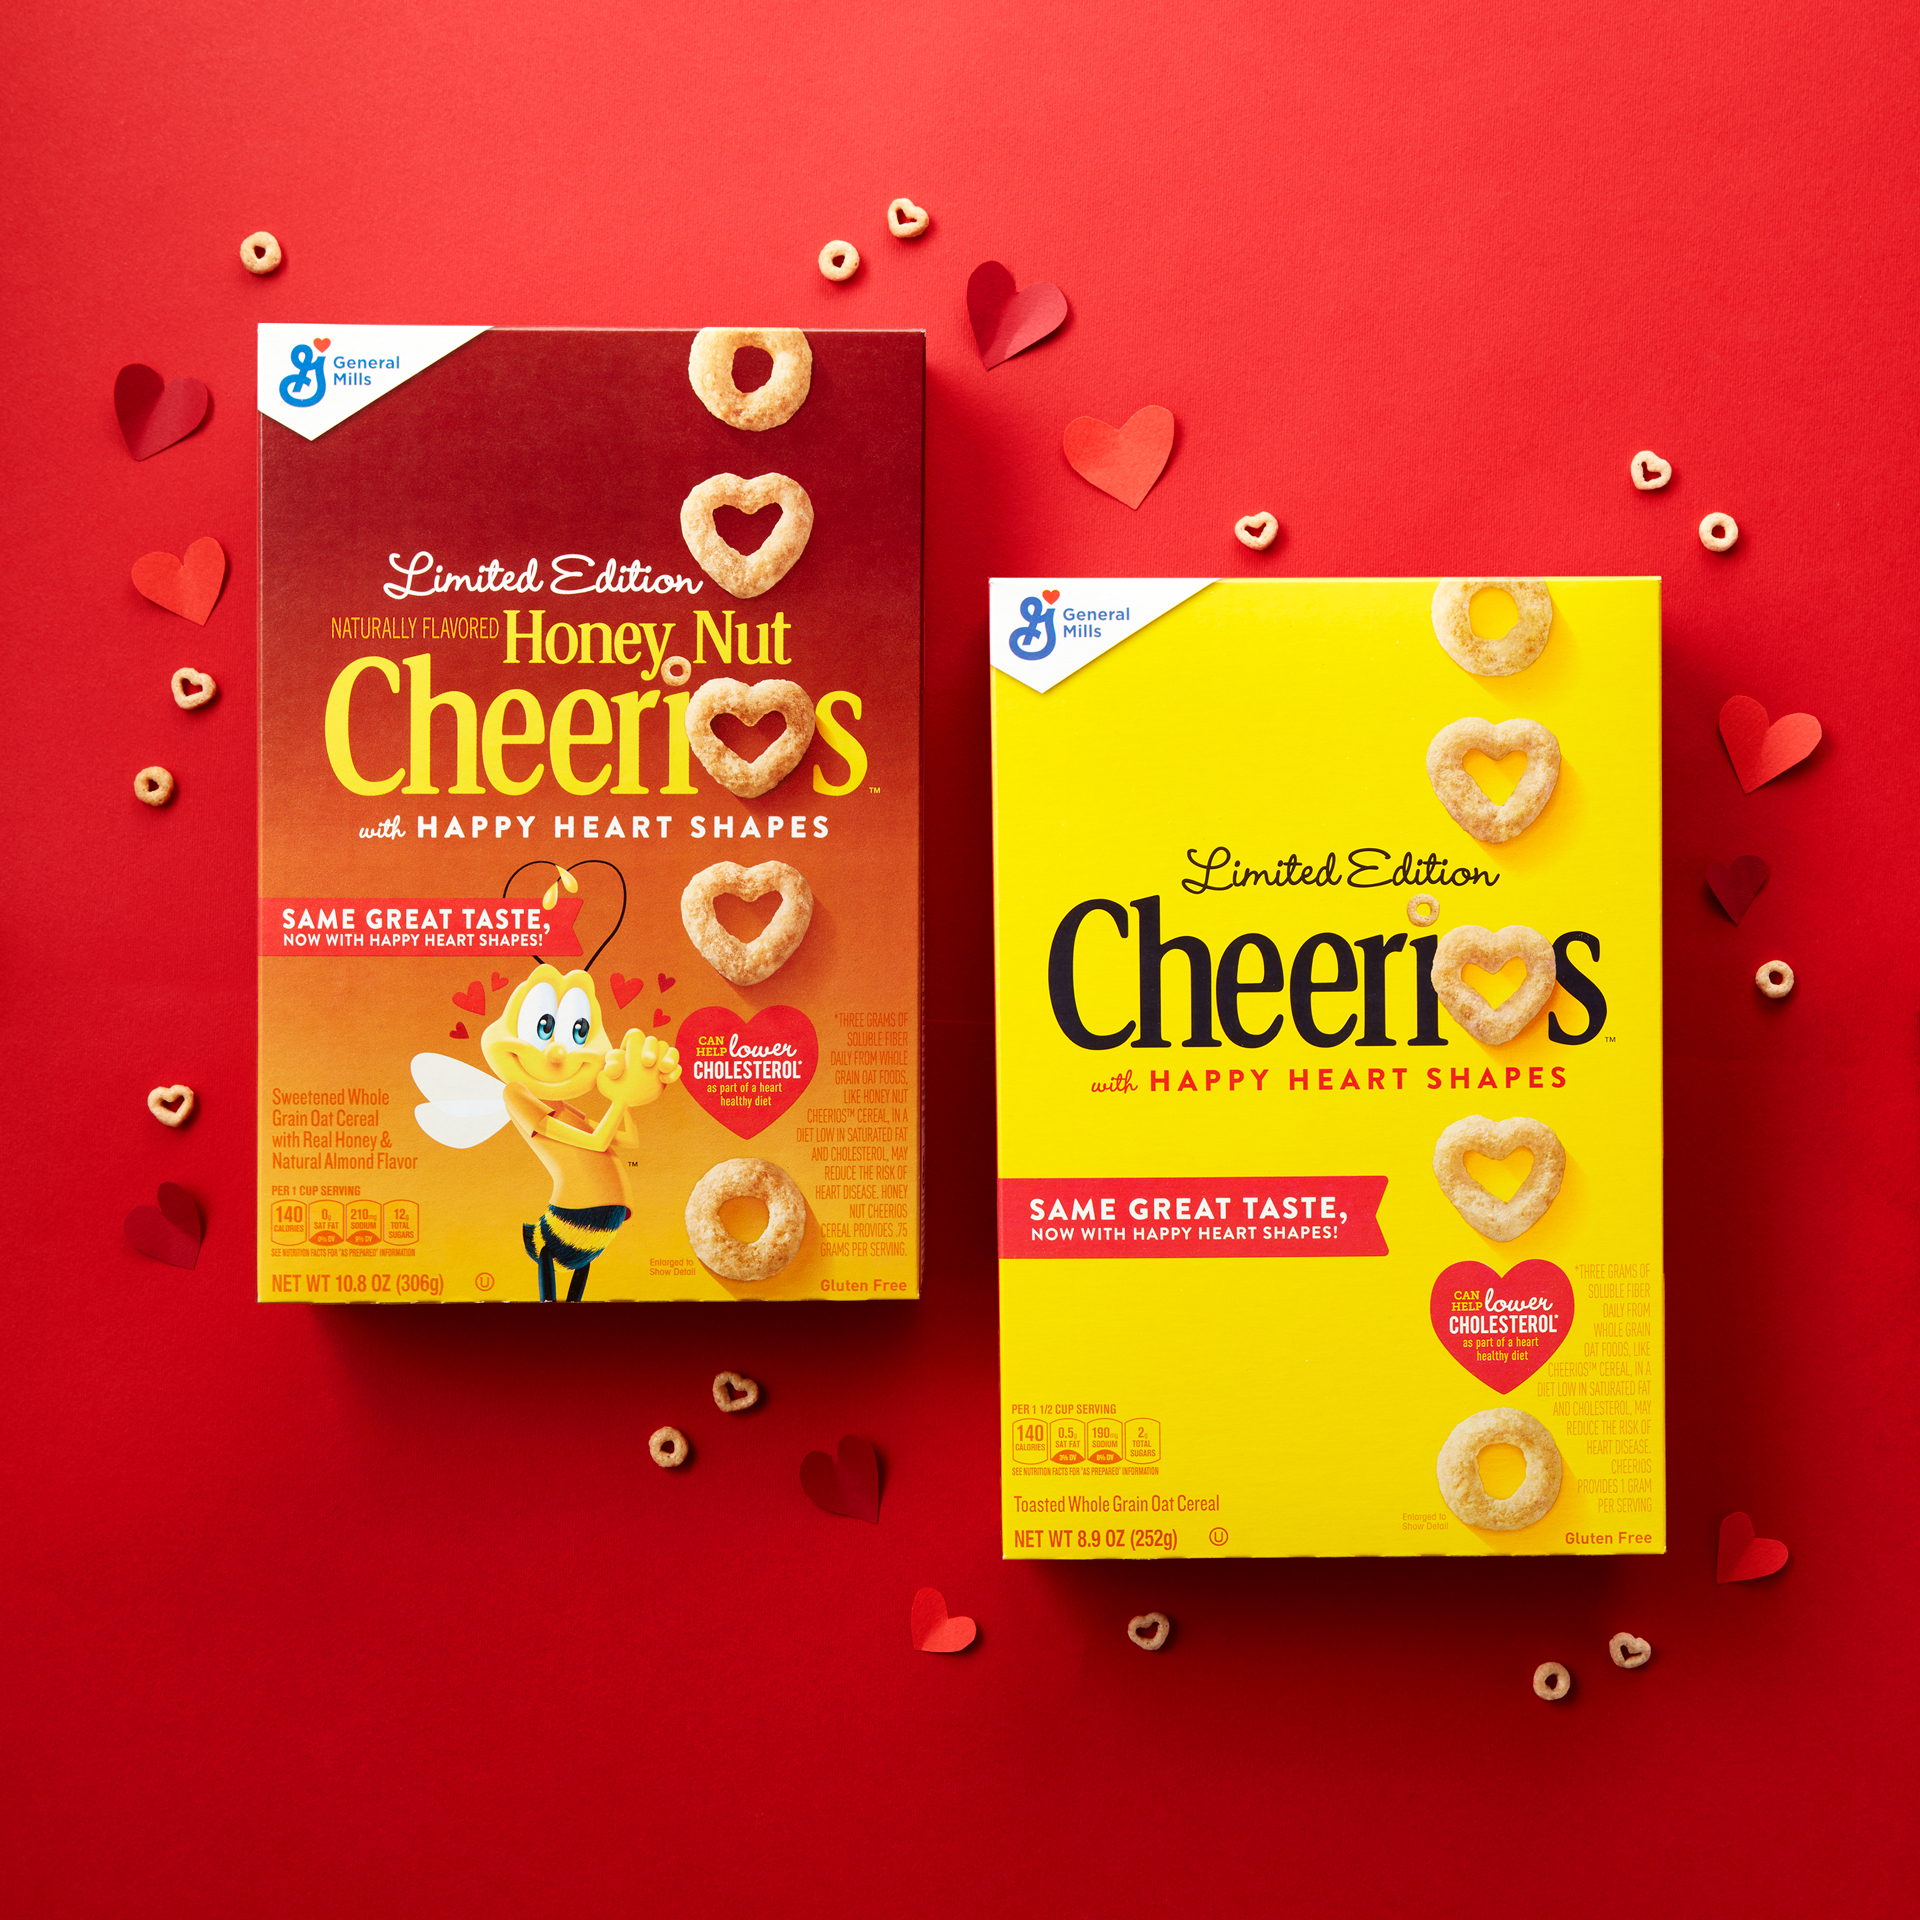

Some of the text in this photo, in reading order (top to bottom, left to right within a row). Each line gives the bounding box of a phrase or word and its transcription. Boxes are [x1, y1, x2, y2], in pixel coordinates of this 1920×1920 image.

[333, 355, 400, 369] General
[333, 373, 372, 386] Mills
[383, 551, 703, 599] Limited Edition
[1063, 607, 1130, 621] General
[1063, 625, 1102, 638] Mills
[331, 610, 791, 681] NATURALLY FLAVORED Honey Nut
[324, 653, 868, 797] Cheerios
[359, 815, 829, 842] with HAPPY HEART SHAPES
[1181, 846, 1500, 894] Limited Edition
[282, 908, 550, 934] SAME GREAT TASTE,
[283, 934, 543, 946] NOW WITH HAPPY HEART SHAPES!
[1047, 893, 1608, 1050] Cheerios
[866, 1012, 896, 1027] GRAMS
[898, 1012, 908, 1027] OF
[695, 1033, 797, 1058] HELP lower
[698, 1036, 725, 1046] CAN
[847, 1032, 908, 1046] SOLUBLE FIBER
[1091, 1066, 1566, 1094] with HAPPY HEART SHAPES
[707, 1082, 782, 1095] as part of a heart
[272, 1088, 389, 1105] Sweetened Whole
[720, 1096, 772, 1108] healthy diet
[844, 1089, 908, 1104] LIKE HONEY NUT
[272, 1109, 379, 1127] Grain Oat Cereal
[272, 1130, 392, 1151] with Real Honey &
[272, 1152, 418, 1170] Natural Almond Flavor
[271, 1185, 361, 1196] PER 1 CUP SERVING
[275, 1205, 303, 1223] 140
[849, 1203, 908, 1219] NUT CHEERIOS
[1029, 1196, 1348, 1224] SAME GREAT TASTE,
[273, 1225, 304, 1233] CALORIES
[313, 1222, 339, 1230] SAT FAT
[350, 1222, 377, 1230] SODIUM
[391, 1222, 410, 1230] TOTAL
[1031, 1225, 1339, 1241] NOW WITH HAPPY HEART SHAPES!
[388, 1231, 414, 1239] SUGARS
[650, 1258, 684, 1268] Enlarged
[650, 1268, 696, 1276] Show Detail
[272, 1274, 444, 1296] NET WT 10.8 OZ (306g)
[820, 1279, 907, 1292] Gluten Free
[1588, 1283, 1651, 1298] SOLUBLE FIBER
[1451, 1288, 1553, 1313] HELP lower
[1454, 1291, 1480, 1301] CAN
[1603, 1303, 1651, 1318] DAILY FROM
[1594, 1322, 1651, 1337] WHOLE GRAIN
[1463, 1336, 1539, 1350] as part of a heart
[1476, 1350, 1528, 1363] healthy diet
[1012, 1404, 1117, 1414] PER 1 1/2 CUP SERVING
[1017, 1424, 1044, 1442] 140
[1015, 1443, 1045, 1451] CALORIES
[1055, 1440, 1080, 1448] SAT FAT
[1092, 1440, 1118, 1448] SODIUM
[1132, 1440, 1152, 1448] TOTAL
[1130, 1449, 1156, 1457] SUGARS
[1611, 1459, 1652, 1474] CHEERIOS
[1578, 1479, 1618, 1494] PROVIDES
[1628, 1478, 1652, 1493] GRAM
[1014, 1494, 1220, 1513] Toasted Whole Grain Oat Cereal
[1402, 1513, 1447, 1523] Enlarged to
[1402, 1522, 1449, 1531] Show Detail
[1014, 1529, 1178, 1550] NET WT 8.9 OZ (252g)
[1565, 1532, 1652, 1545] Gluten Free
